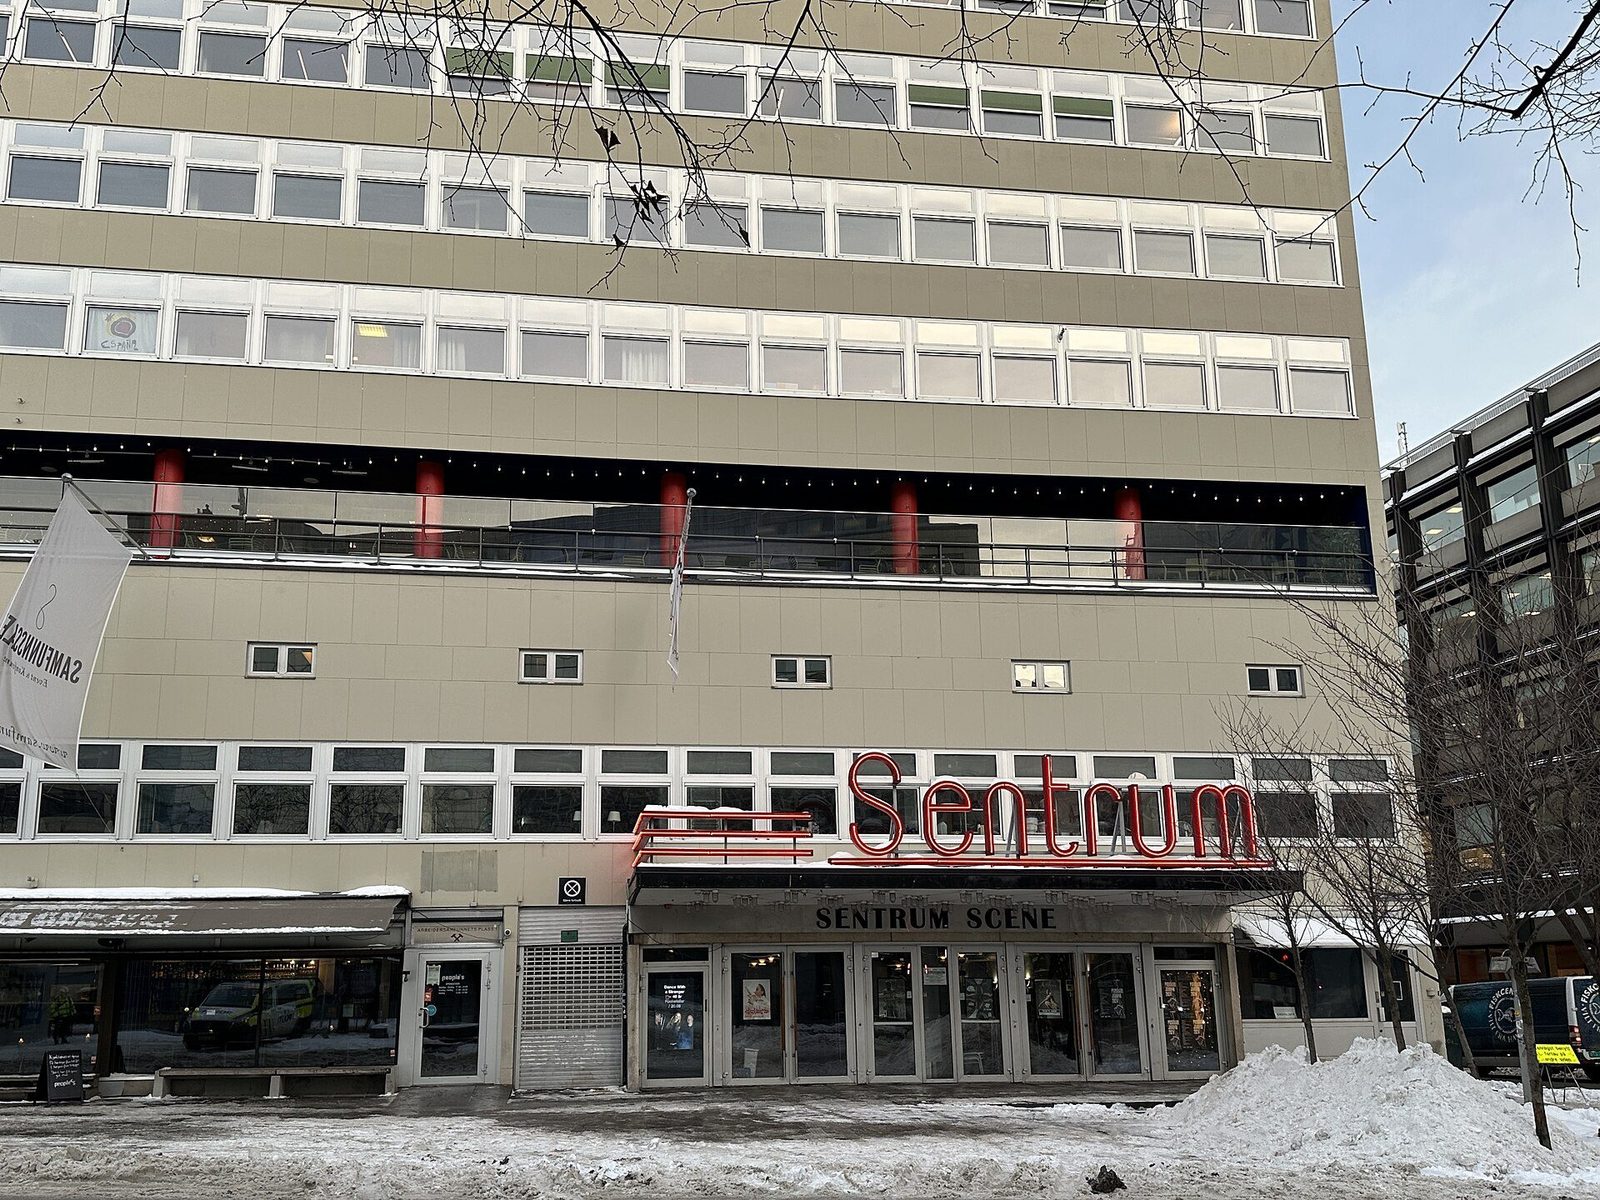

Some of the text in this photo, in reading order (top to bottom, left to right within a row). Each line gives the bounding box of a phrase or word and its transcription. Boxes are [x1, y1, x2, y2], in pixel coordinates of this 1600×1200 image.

[848, 751, 1257, 858] Sentrum
[816, 907, 1057, 930] SENTRUM SCENE
[1489, 987, 1514, 1009] FISKCEN
[1581, 983, 1600, 1003] FISKC
